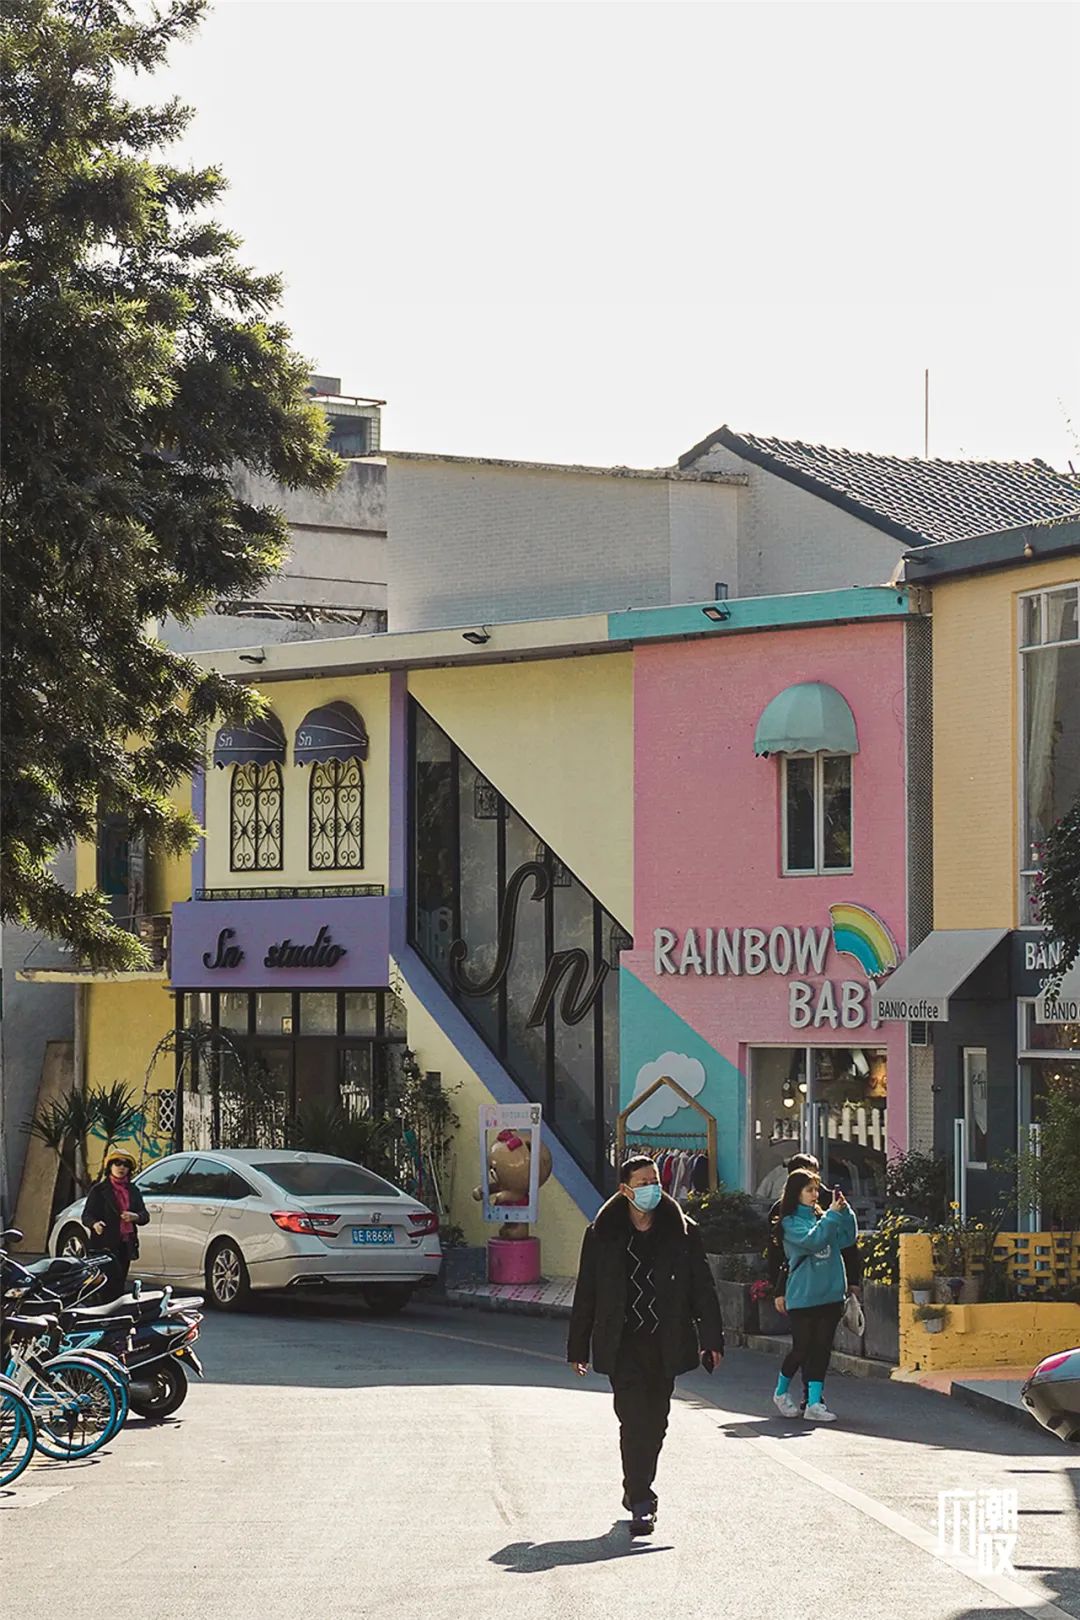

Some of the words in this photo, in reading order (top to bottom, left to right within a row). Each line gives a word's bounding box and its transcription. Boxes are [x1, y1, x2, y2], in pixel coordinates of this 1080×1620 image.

[218, 732, 233, 747] Sn
[297, 731, 312, 747] Sn
[202, 926, 245, 970] Sn
[263, 924, 348, 969] studio
[450, 861, 611, 1029] Sn
[654, 926, 831, 977] RAINBOW
[878, 1000, 907, 1019] BANJO
[908, 1000, 939, 1019] coffee
[1043, 1002, 1077, 1021] BANJO
